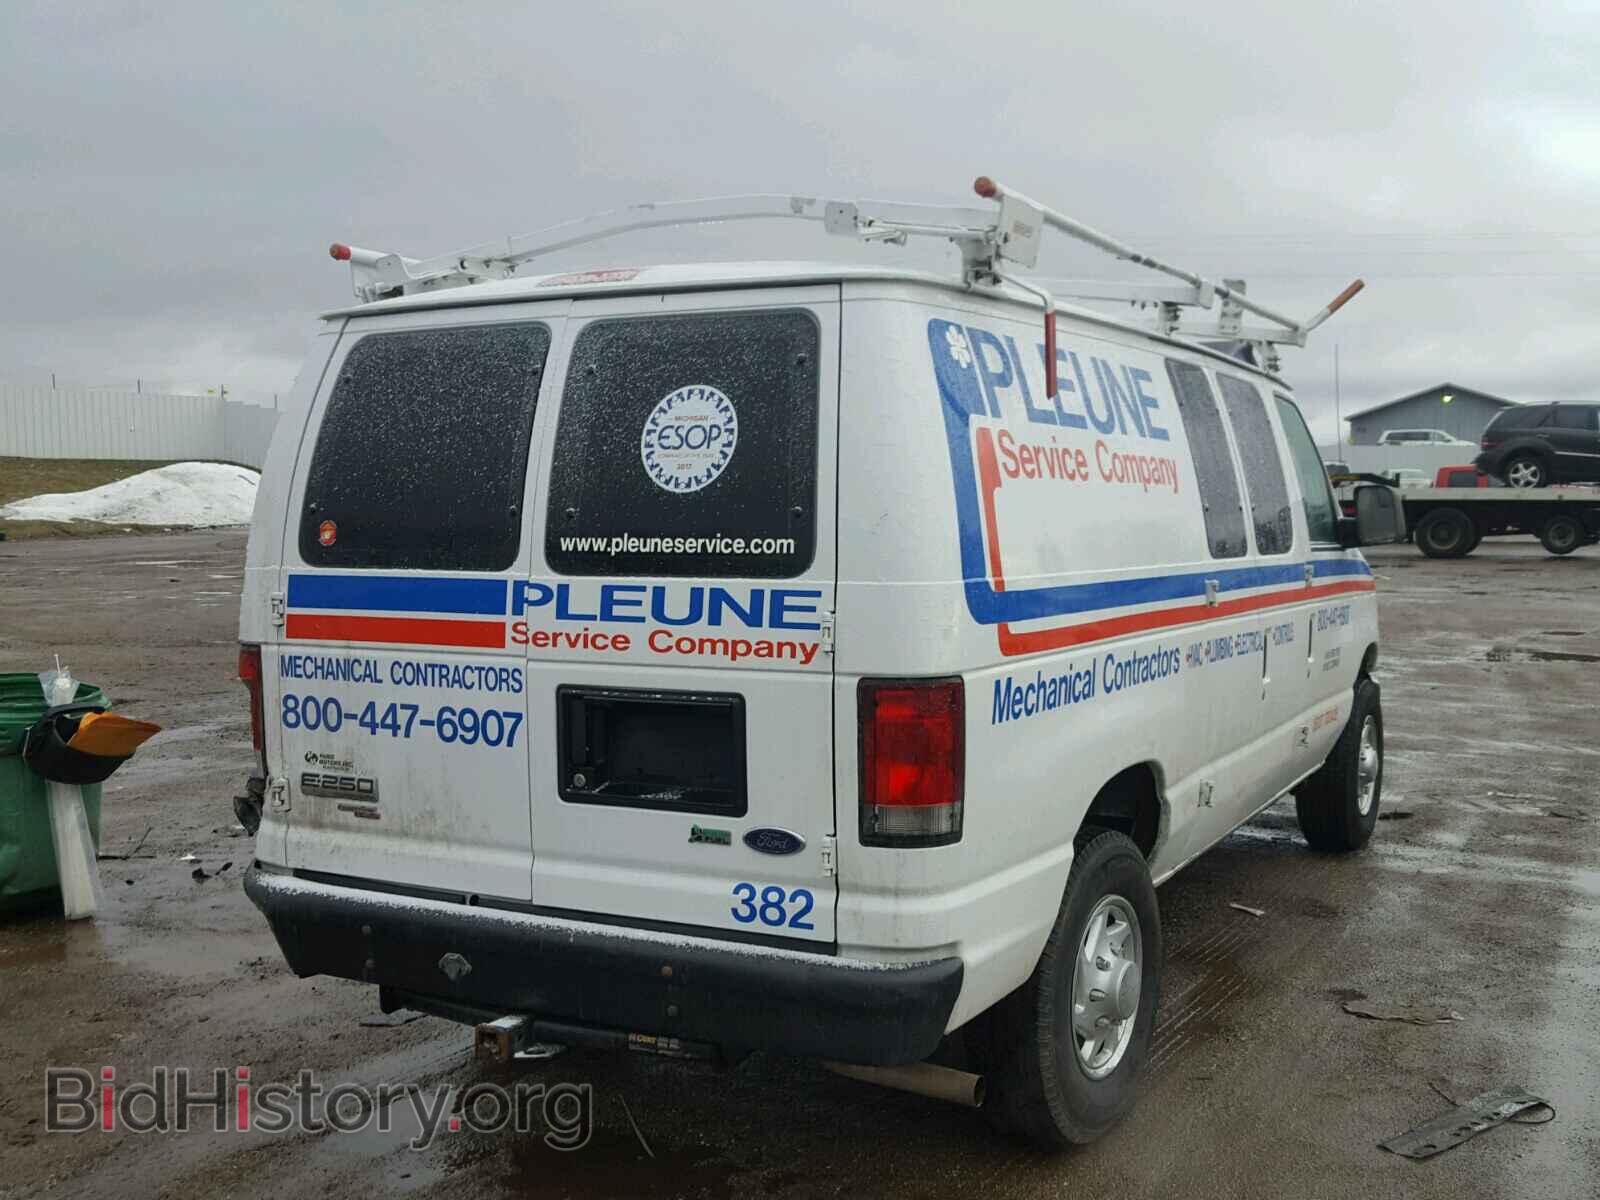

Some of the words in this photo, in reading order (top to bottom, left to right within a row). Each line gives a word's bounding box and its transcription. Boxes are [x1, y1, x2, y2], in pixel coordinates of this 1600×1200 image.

[964, 326, 1169, 441] PLEUNE
[658, 424, 722, 450] ESOP
[997, 429, 1089, 481] Service
[1096, 440, 1178, 493] Company
[560, 533, 795, 556] www.pleuneservice.com
[511, 580, 822, 630] PLEUNE
[511, 622, 631, 651] Service
[648, 629, 820, 664] Company
[280, 655, 383, 684] MECHANICAL
[390, 660, 523, 693] CONTRACTORS
[991, 659, 1096, 725] Mechanical
[1102, 646, 1180, 694] Contractors
[282, 694, 523, 748] 800-447-6907
[731, 882, 814, 930] 382
